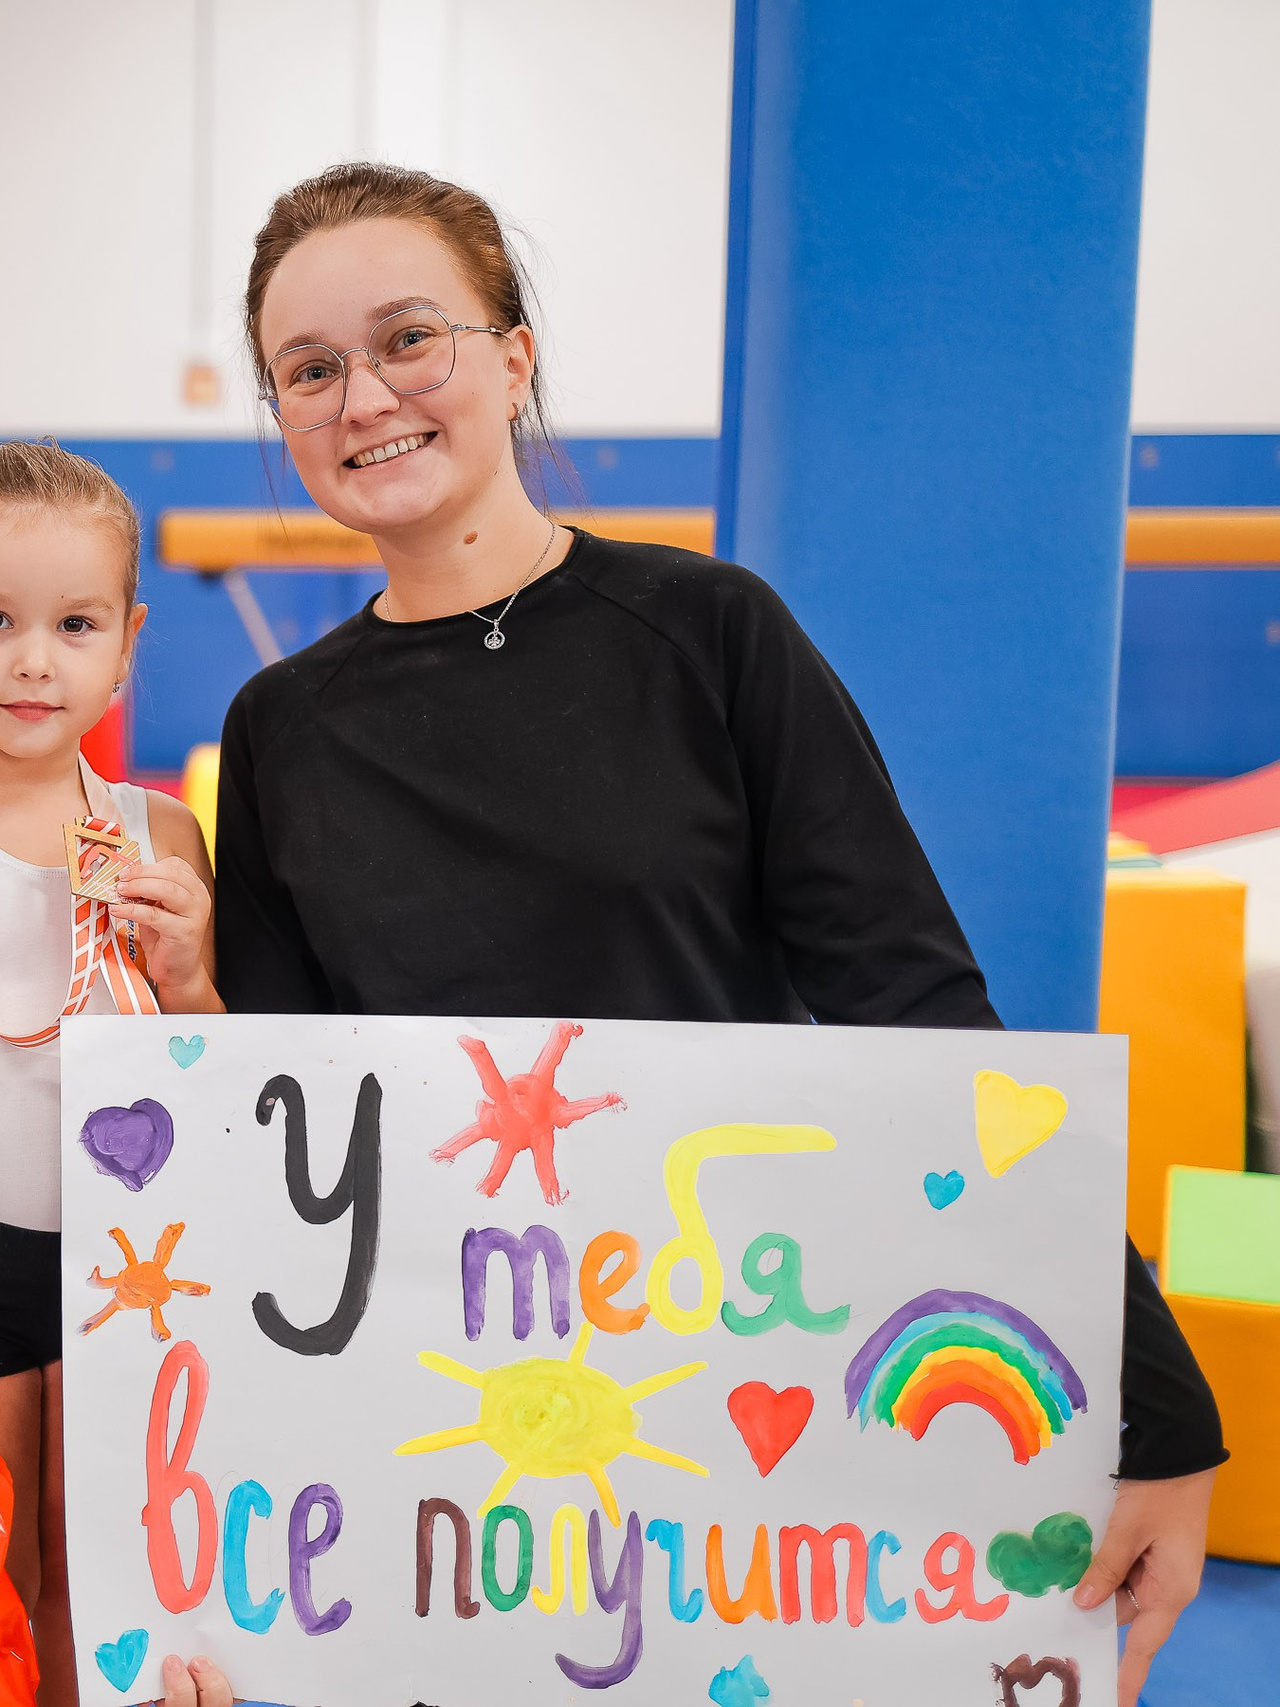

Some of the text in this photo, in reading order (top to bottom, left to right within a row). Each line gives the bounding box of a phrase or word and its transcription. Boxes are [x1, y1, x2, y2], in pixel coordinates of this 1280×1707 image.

[251, 1072, 852, 1356] У тебя
[140, 1339, 1011, 1690] все получится
